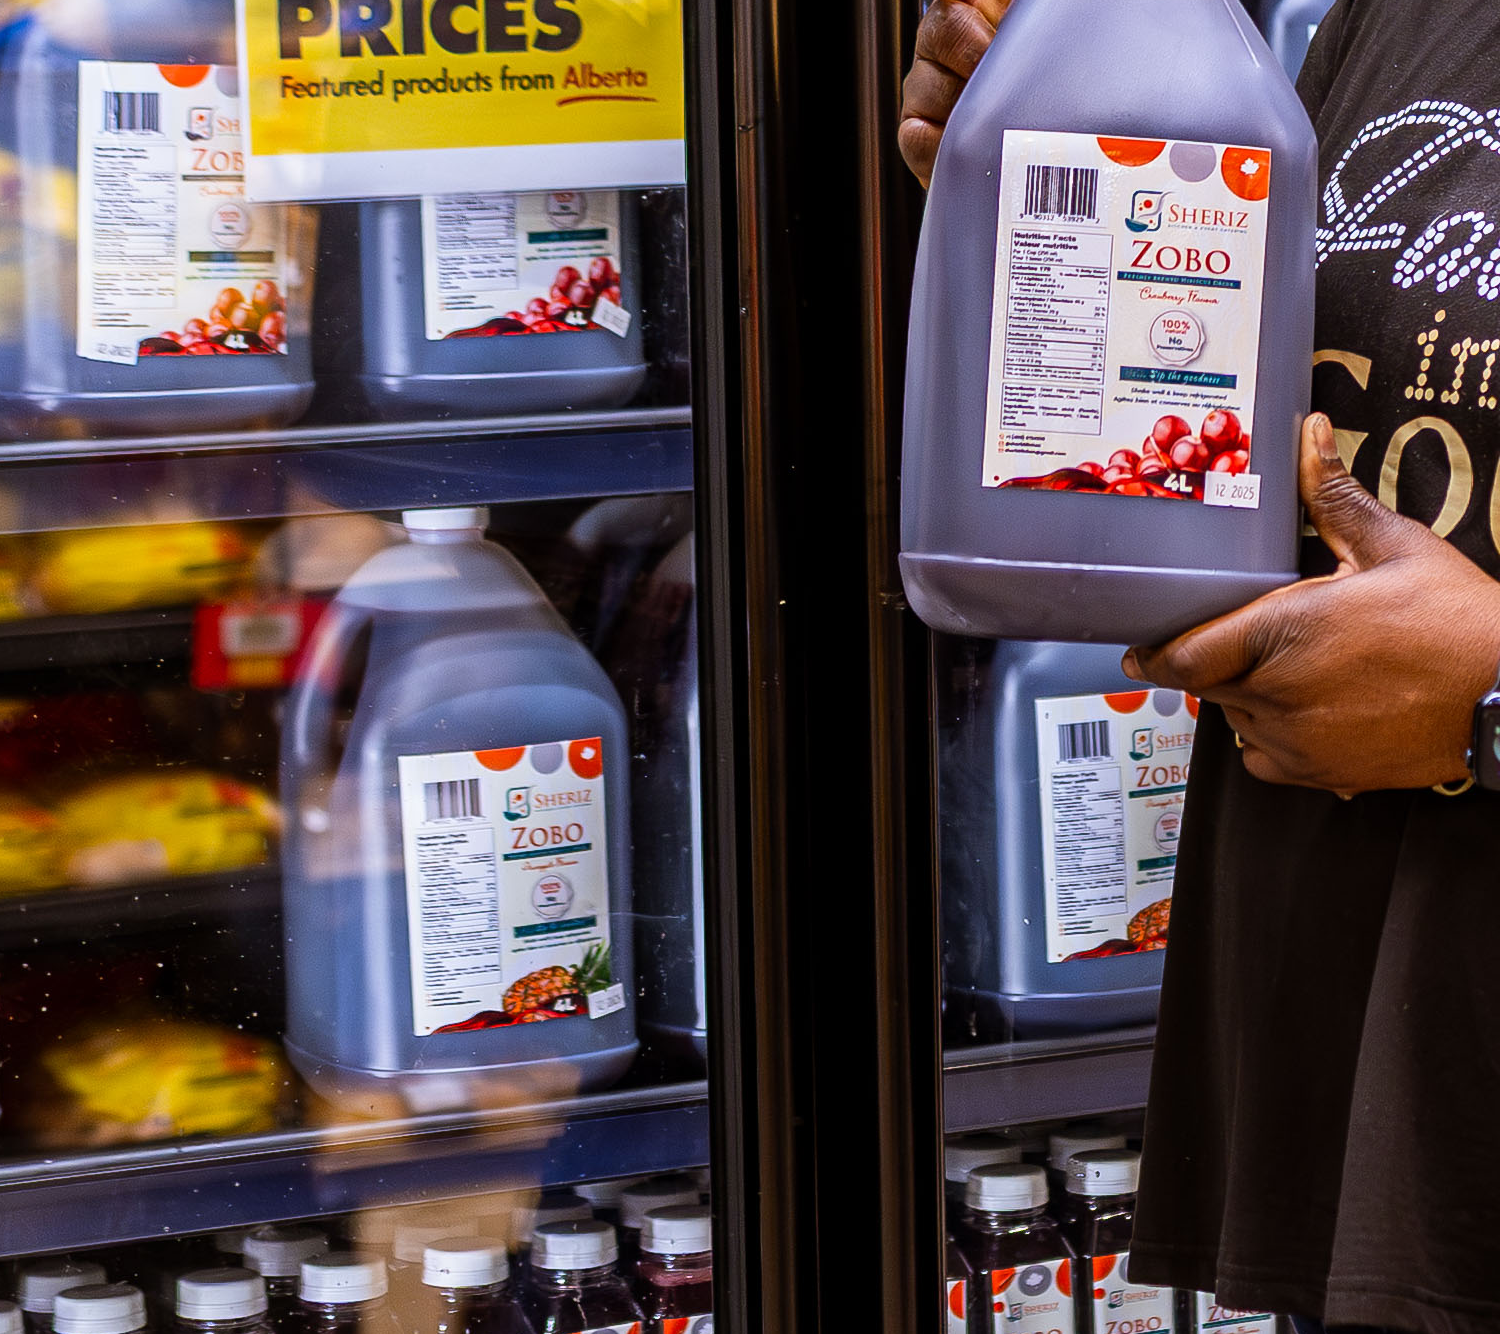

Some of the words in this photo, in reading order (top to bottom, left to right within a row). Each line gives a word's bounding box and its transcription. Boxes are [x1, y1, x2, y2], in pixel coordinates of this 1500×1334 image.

[280, 69, 385, 98] Featured
[393, 68, 492, 102] products
[500, 64, 555, 91] from
[562, 63, 648, 89] Alberta
[192, 148, 245, 171] ZOB
[1168, 203, 1249, 228] SHERIZ
[1130, 240, 1231, 275] ZOBO
[1161, 319, 1191, 331] 100%
[1168, 336, 1183, 346] No
[1405, 310, 1499, 408] in
[1164, 473, 1192, 493] 4L
[1214, 482, 1226, 497] 12
[1231, 485, 1255, 501] 2025
[533, 788, 592, 809] SHERIZ
[511, 822, 583, 849] ZOBO
